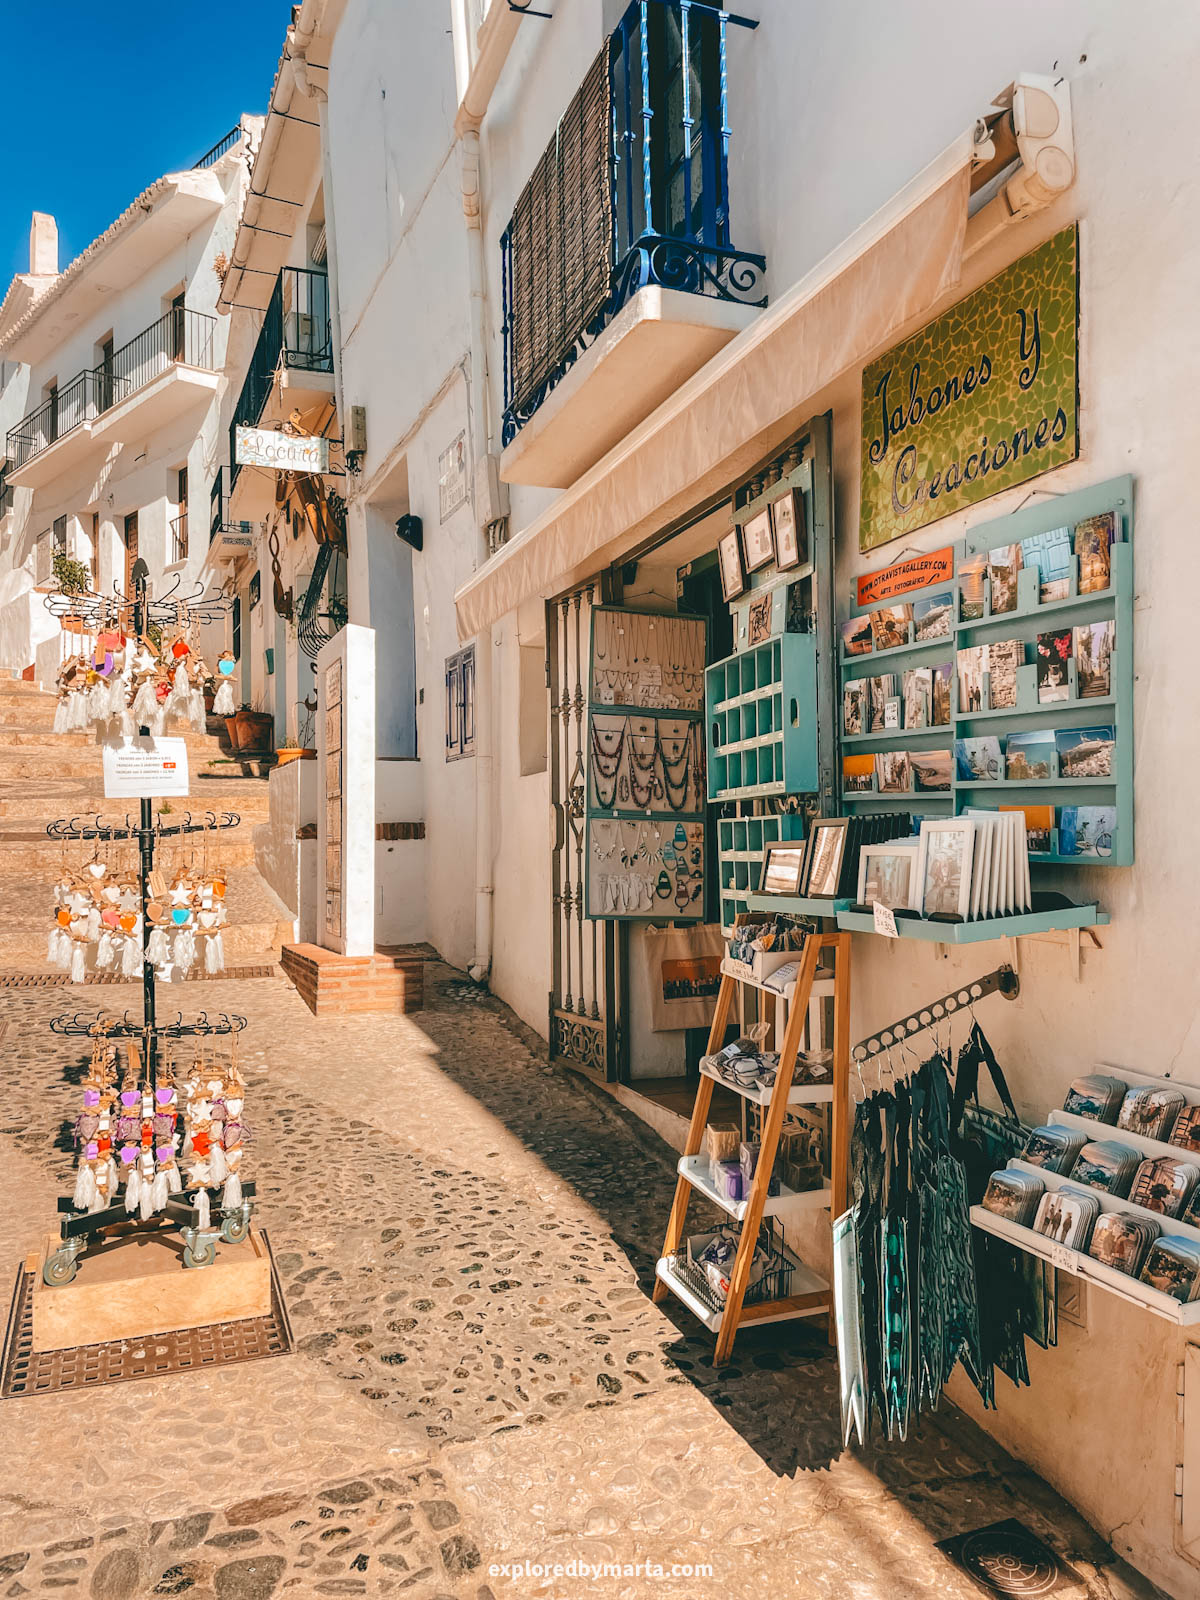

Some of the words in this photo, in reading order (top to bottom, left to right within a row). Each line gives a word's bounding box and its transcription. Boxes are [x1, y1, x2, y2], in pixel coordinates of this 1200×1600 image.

[868, 354, 992, 465] Jabones
[248, 435, 319, 464] Locura
[892, 408, 1068, 514] Creaciones
[861, 560, 948, 595] WWW.OTRAVISTAGALLERY.COM
[880, 586, 892, 595] ARTE
